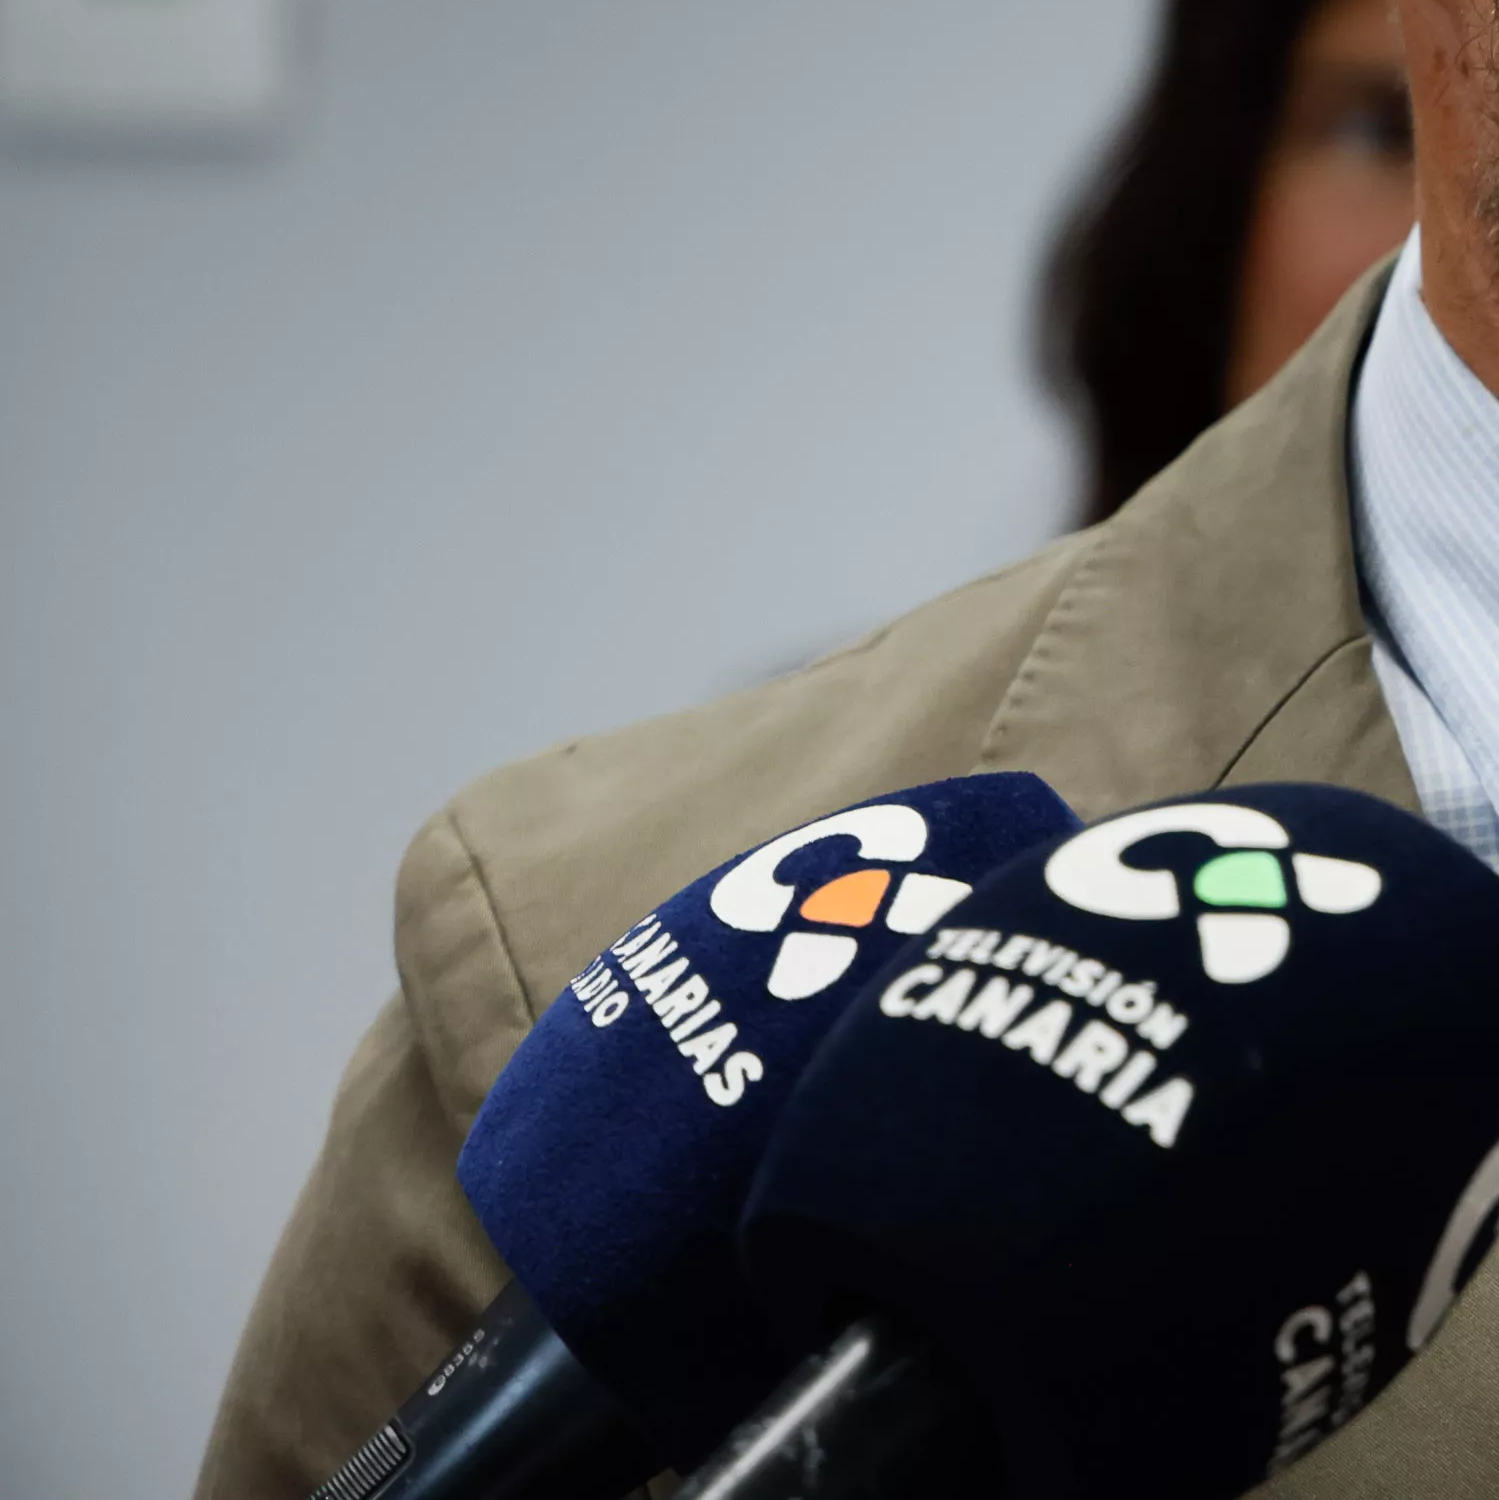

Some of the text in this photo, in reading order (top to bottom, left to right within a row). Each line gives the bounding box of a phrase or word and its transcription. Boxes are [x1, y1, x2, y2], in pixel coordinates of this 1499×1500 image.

[570, 955, 629, 1027] ADIO
[926, 929, 1188, 1050] TELEVISIÓN
[879, 963, 1193, 1149] CANARIA
